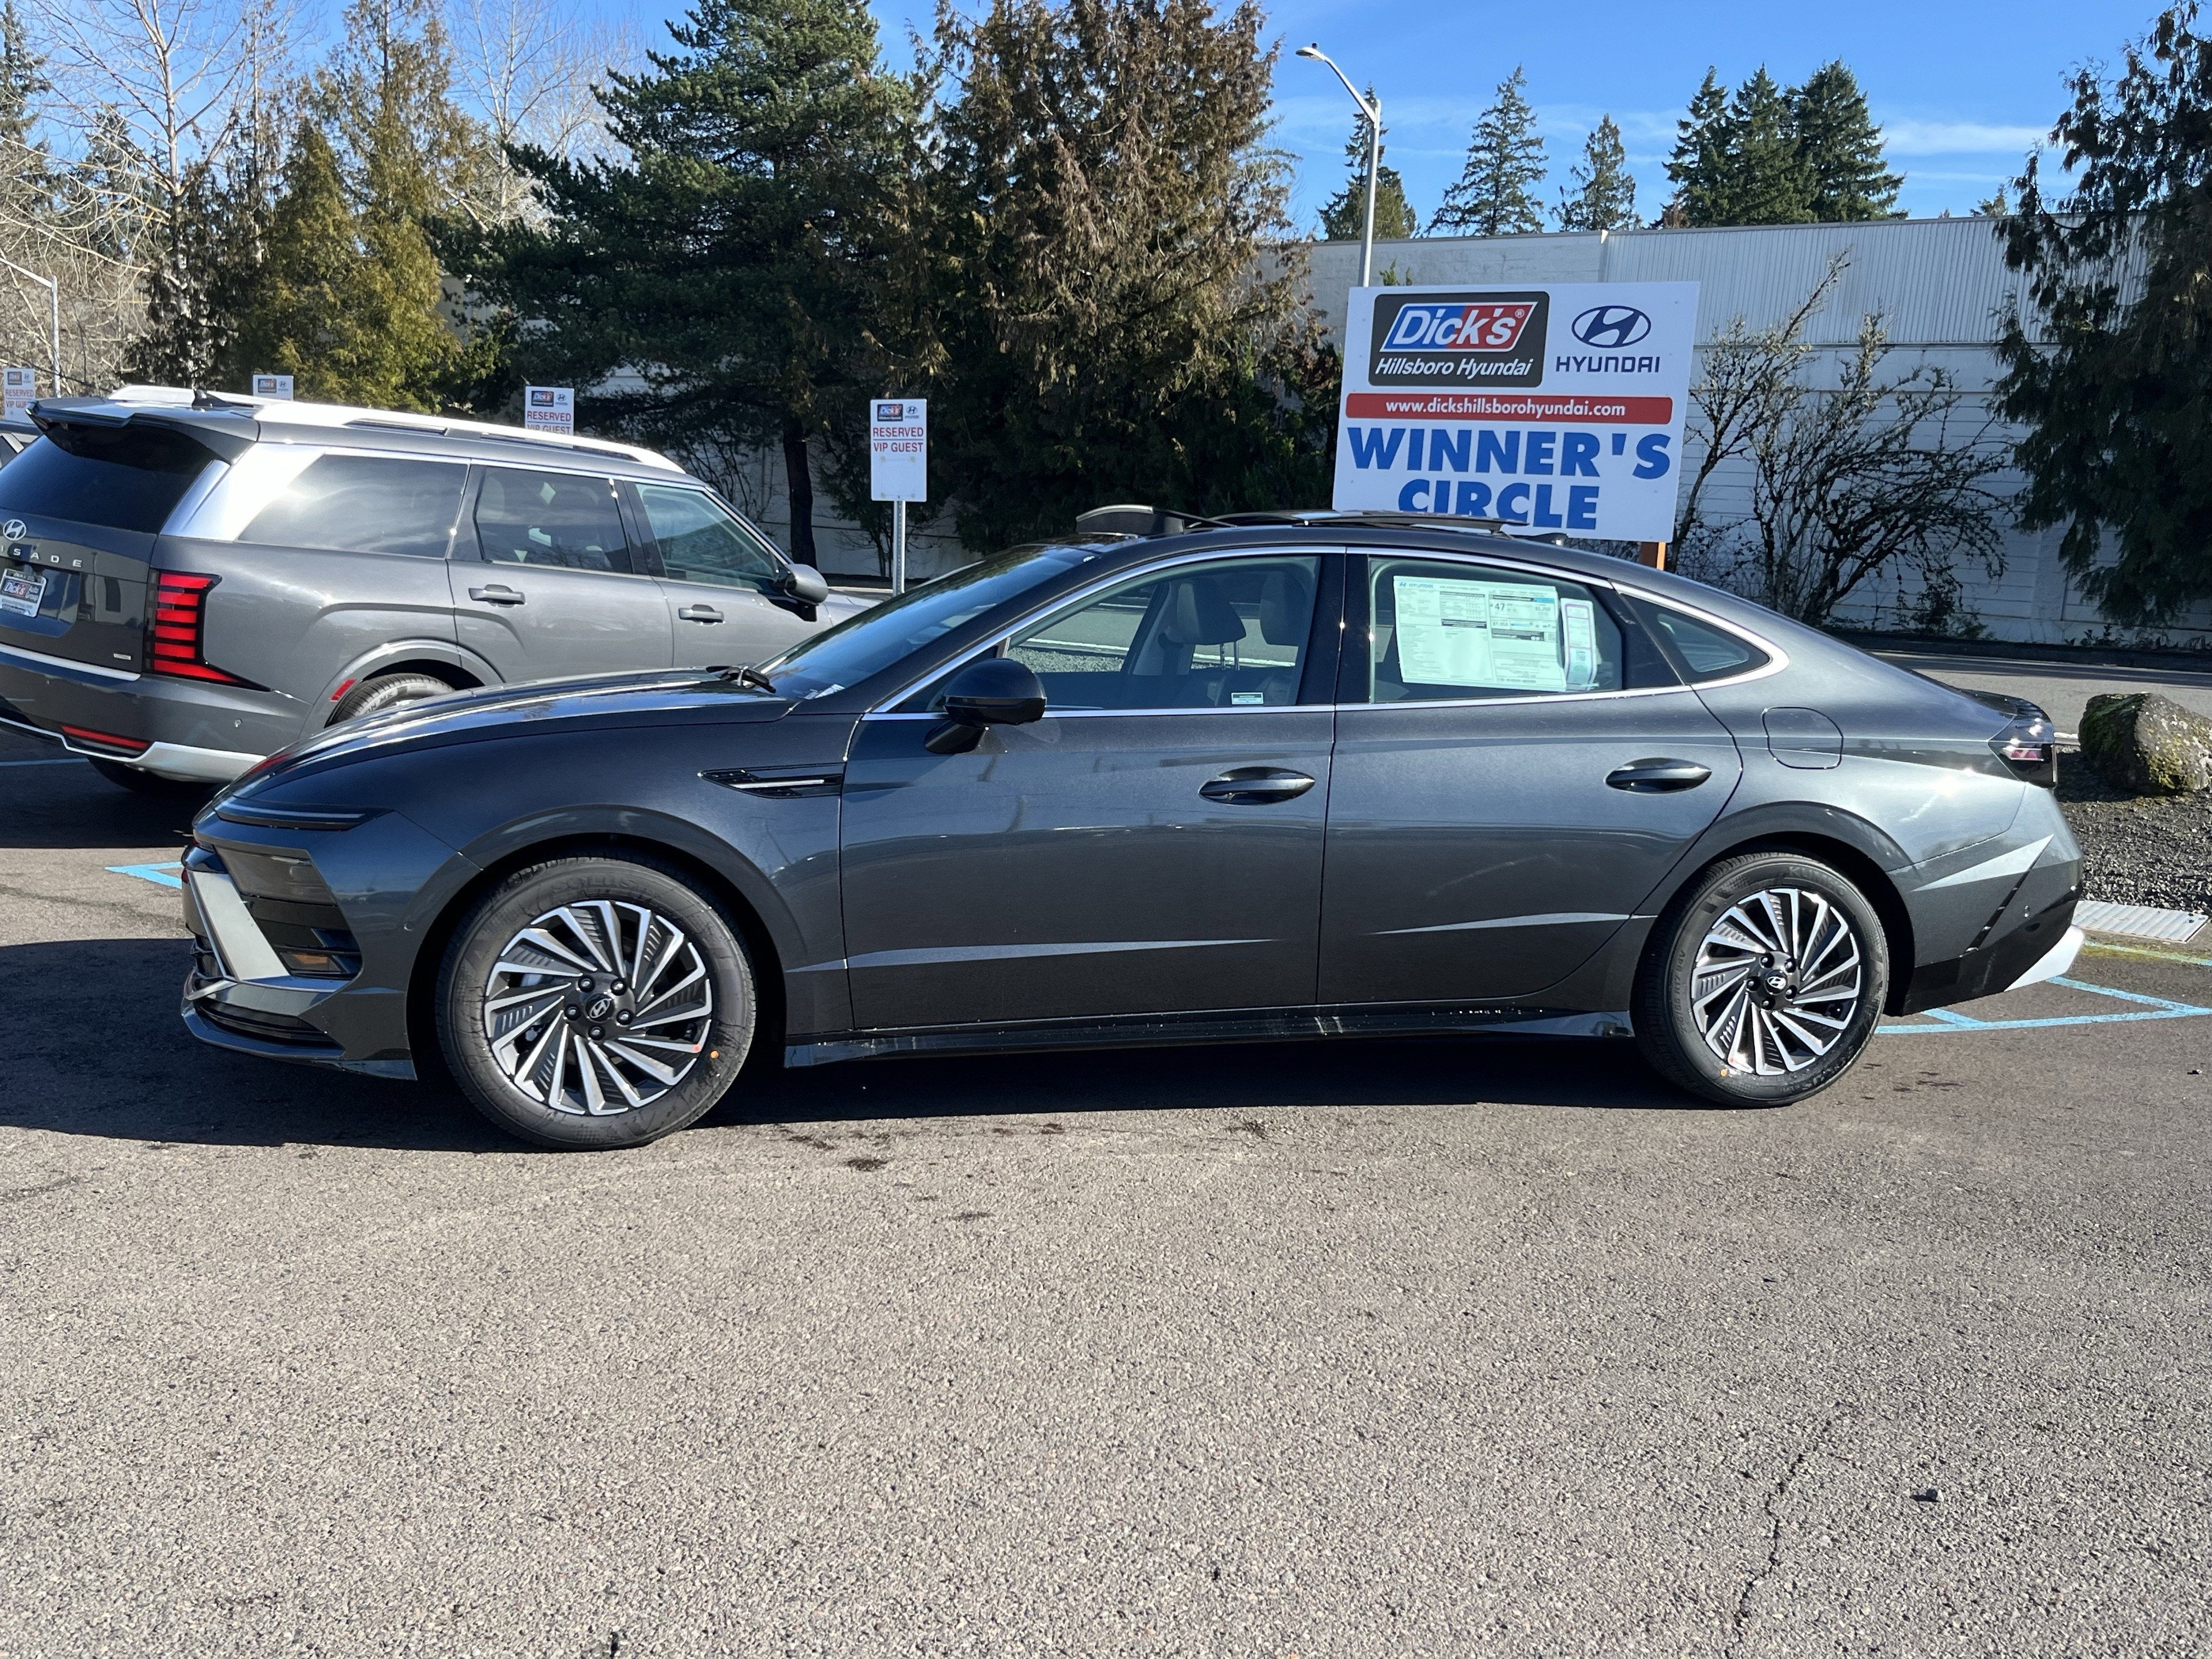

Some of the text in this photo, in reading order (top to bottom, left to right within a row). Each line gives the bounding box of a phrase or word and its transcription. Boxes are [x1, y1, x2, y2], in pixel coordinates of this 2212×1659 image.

[1392, 308, 1516, 346] Dick's
[1375, 358, 1534, 380] Hillsboro Hyundai
[1556, 356, 1661, 374] HYUNDAI
[527, 410, 572, 421] RESERVED
[1386, 397, 1626, 418] www.dickshillsborohyundai.com
[543, 425, 571, 435] GUEST
[873, 427, 924, 437] RESERVED
[873, 442, 924, 453] VIP GUEST
[1347, 427, 1671, 479] WINNER'S
[1398, 479, 1600, 531] CIRCLE
[1495, 603, 1505, 611] 47
